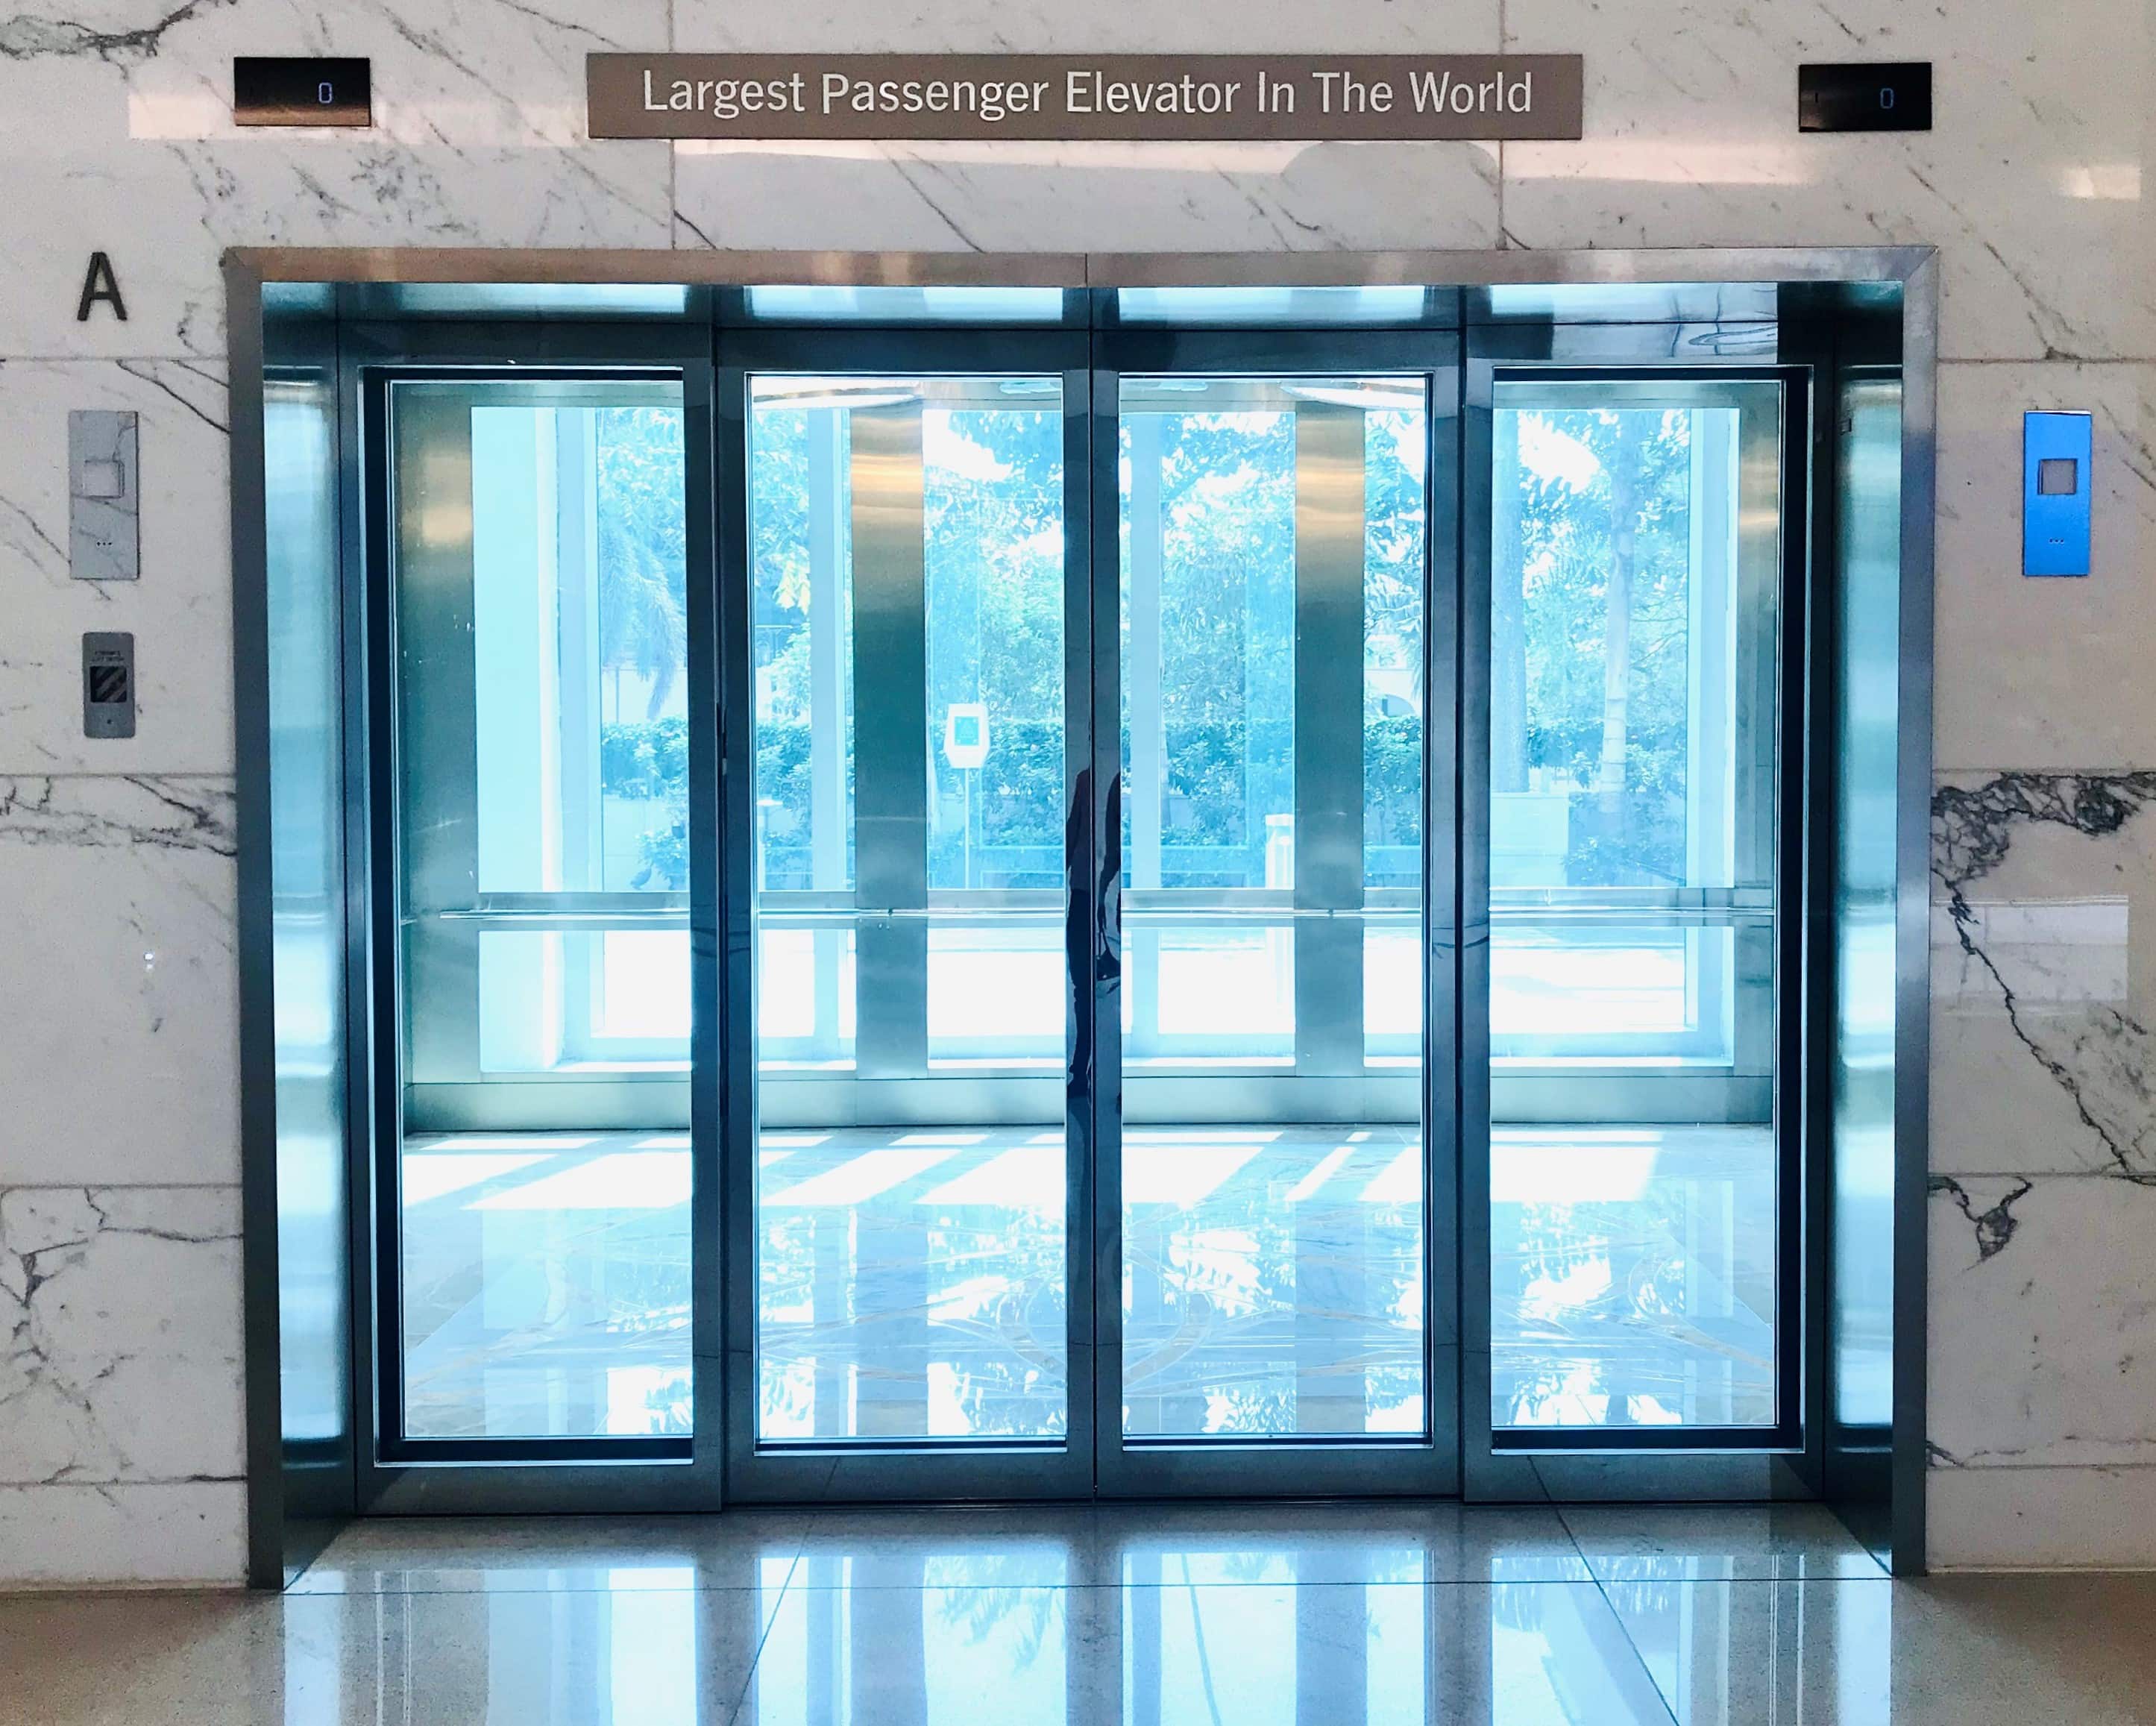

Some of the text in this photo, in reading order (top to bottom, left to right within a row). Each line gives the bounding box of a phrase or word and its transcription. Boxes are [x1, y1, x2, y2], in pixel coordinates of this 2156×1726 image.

[644, 69, 1532, 122] Largest Passenger Elevator In The World
[76, 251, 128, 322] A
